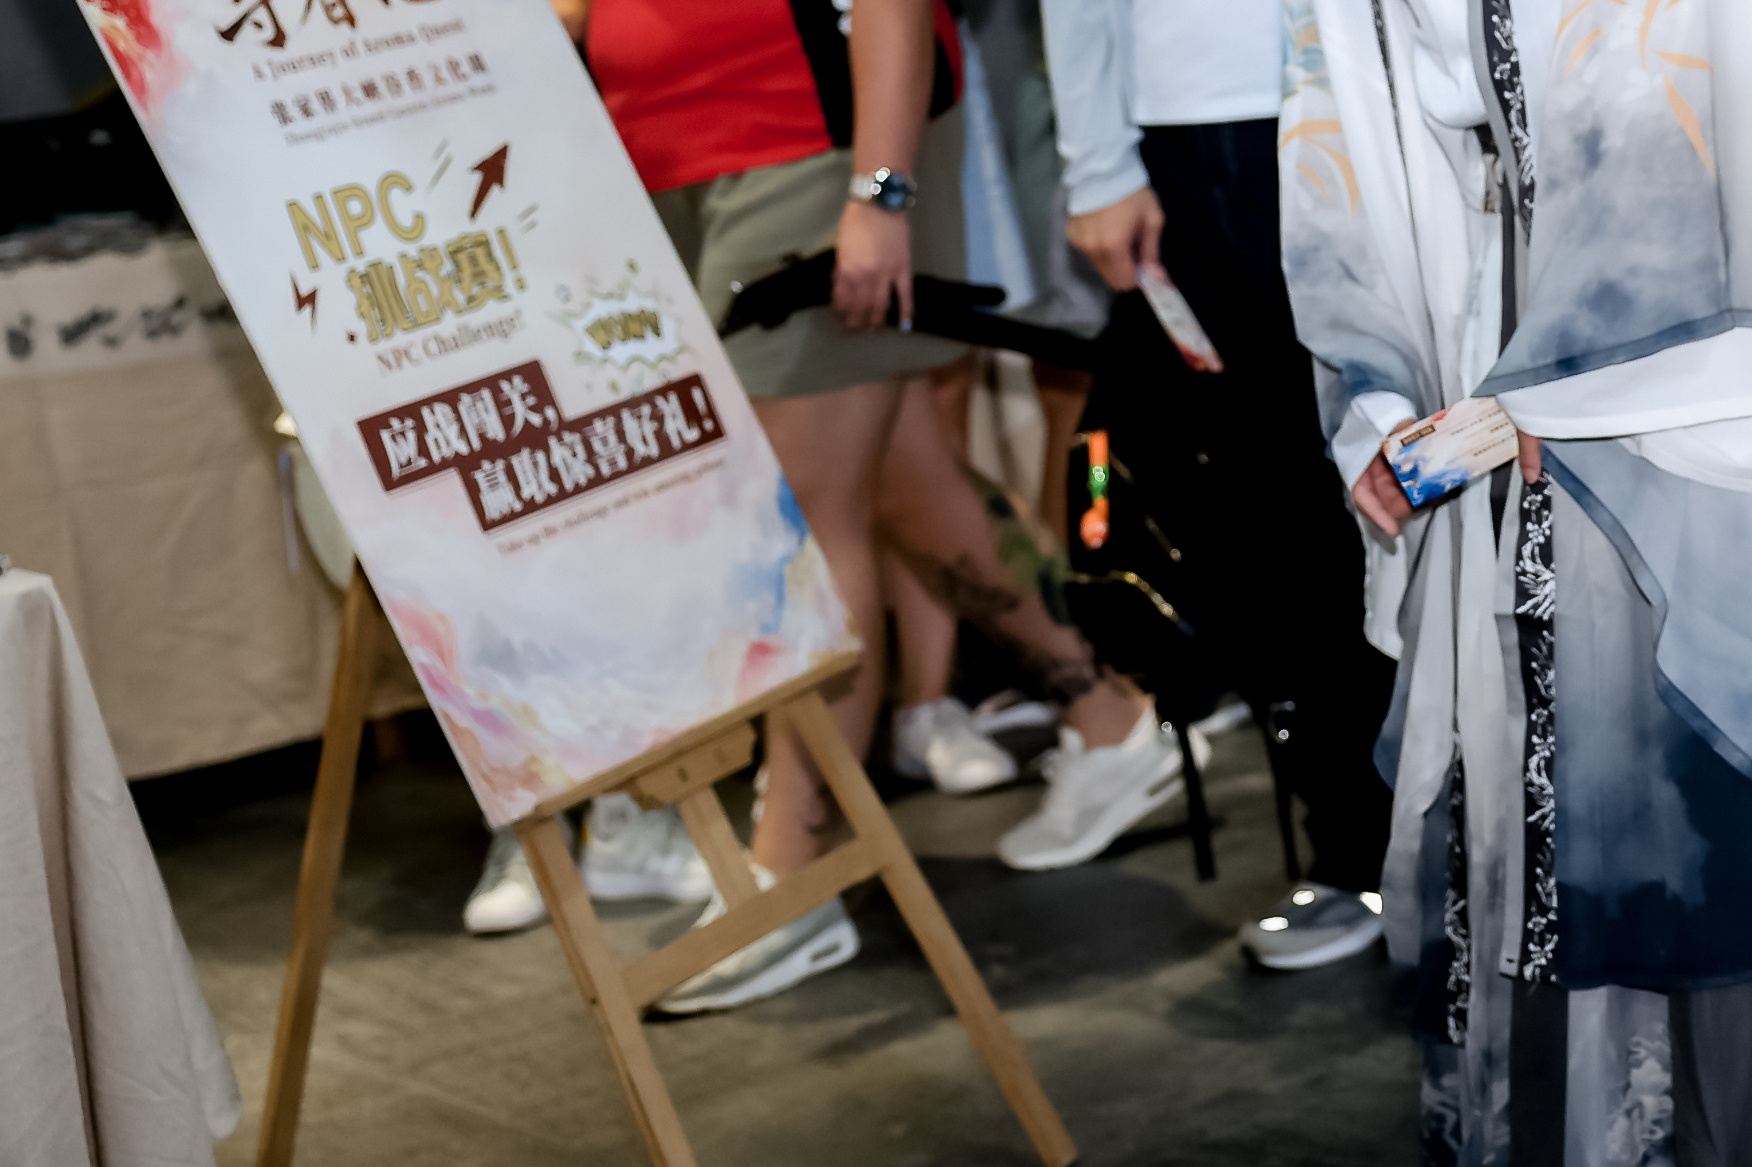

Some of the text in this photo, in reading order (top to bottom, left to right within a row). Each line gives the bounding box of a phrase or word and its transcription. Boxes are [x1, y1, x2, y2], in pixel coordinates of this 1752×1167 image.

[268, 50, 337, 81] Journey
[340, 40, 358, 61] of
[287, 171, 425, 269] NPC
[375, 340, 421, 377] NPC
